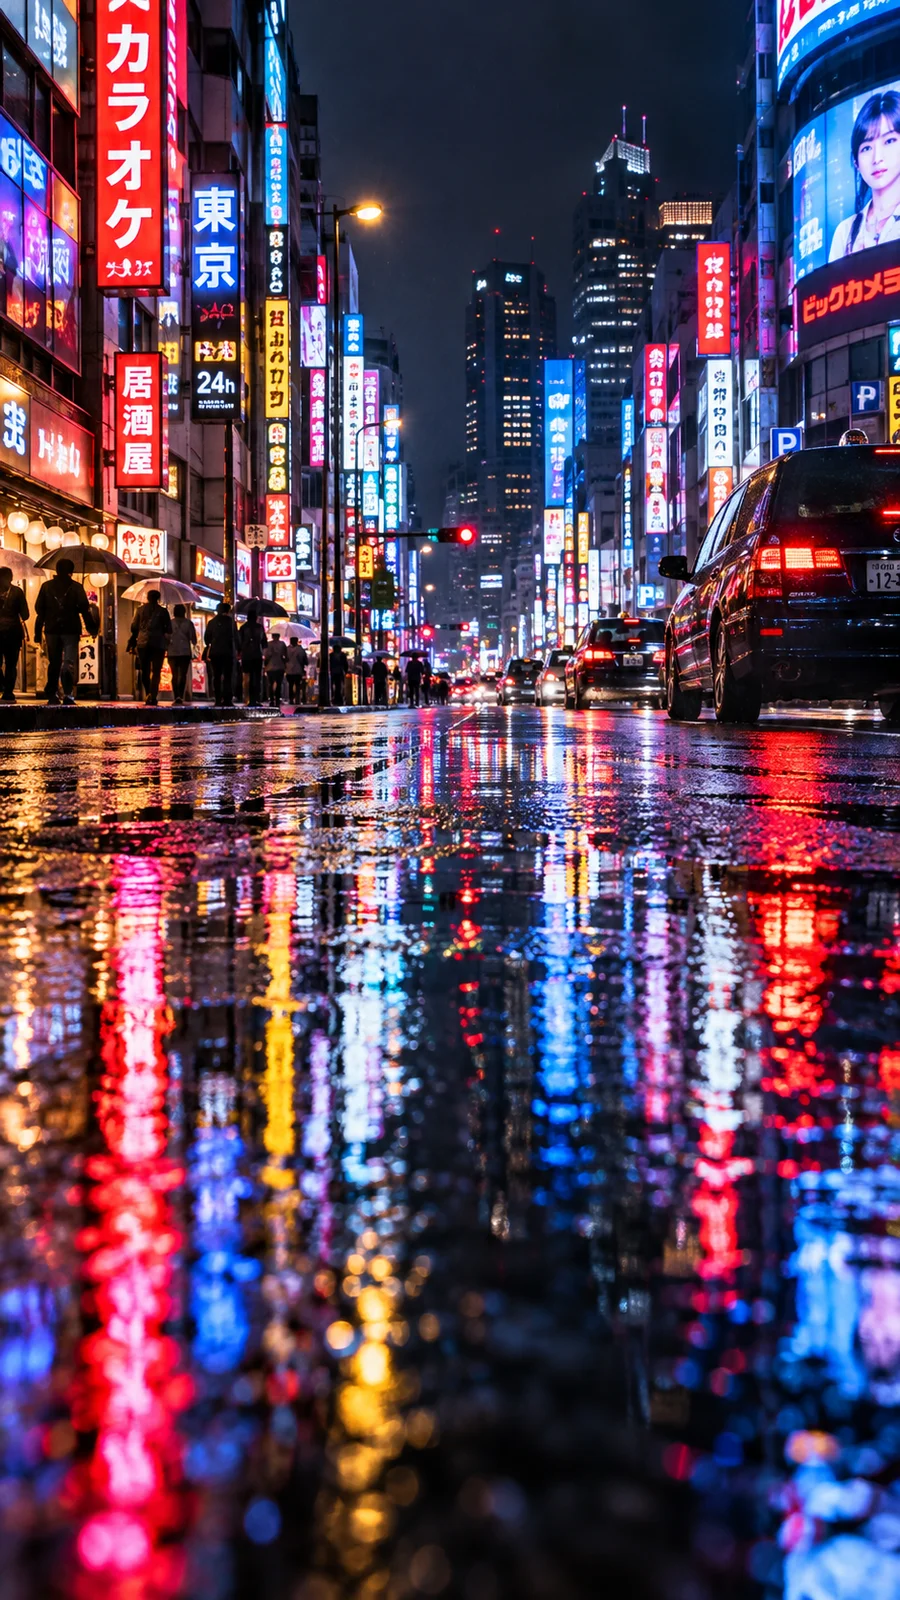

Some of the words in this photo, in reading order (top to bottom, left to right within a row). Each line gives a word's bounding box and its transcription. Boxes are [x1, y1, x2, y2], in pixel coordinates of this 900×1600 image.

[194, 187, 236, 289] 東京
[802, 266, 900, 324] ビックカメラ
[197, 370, 235, 394] 24h
[857, 386, 877, 411] P
[122, 366, 154, 475] 居酒屋
[777, 432, 797, 455] P
[639, 586, 655, 606] P
